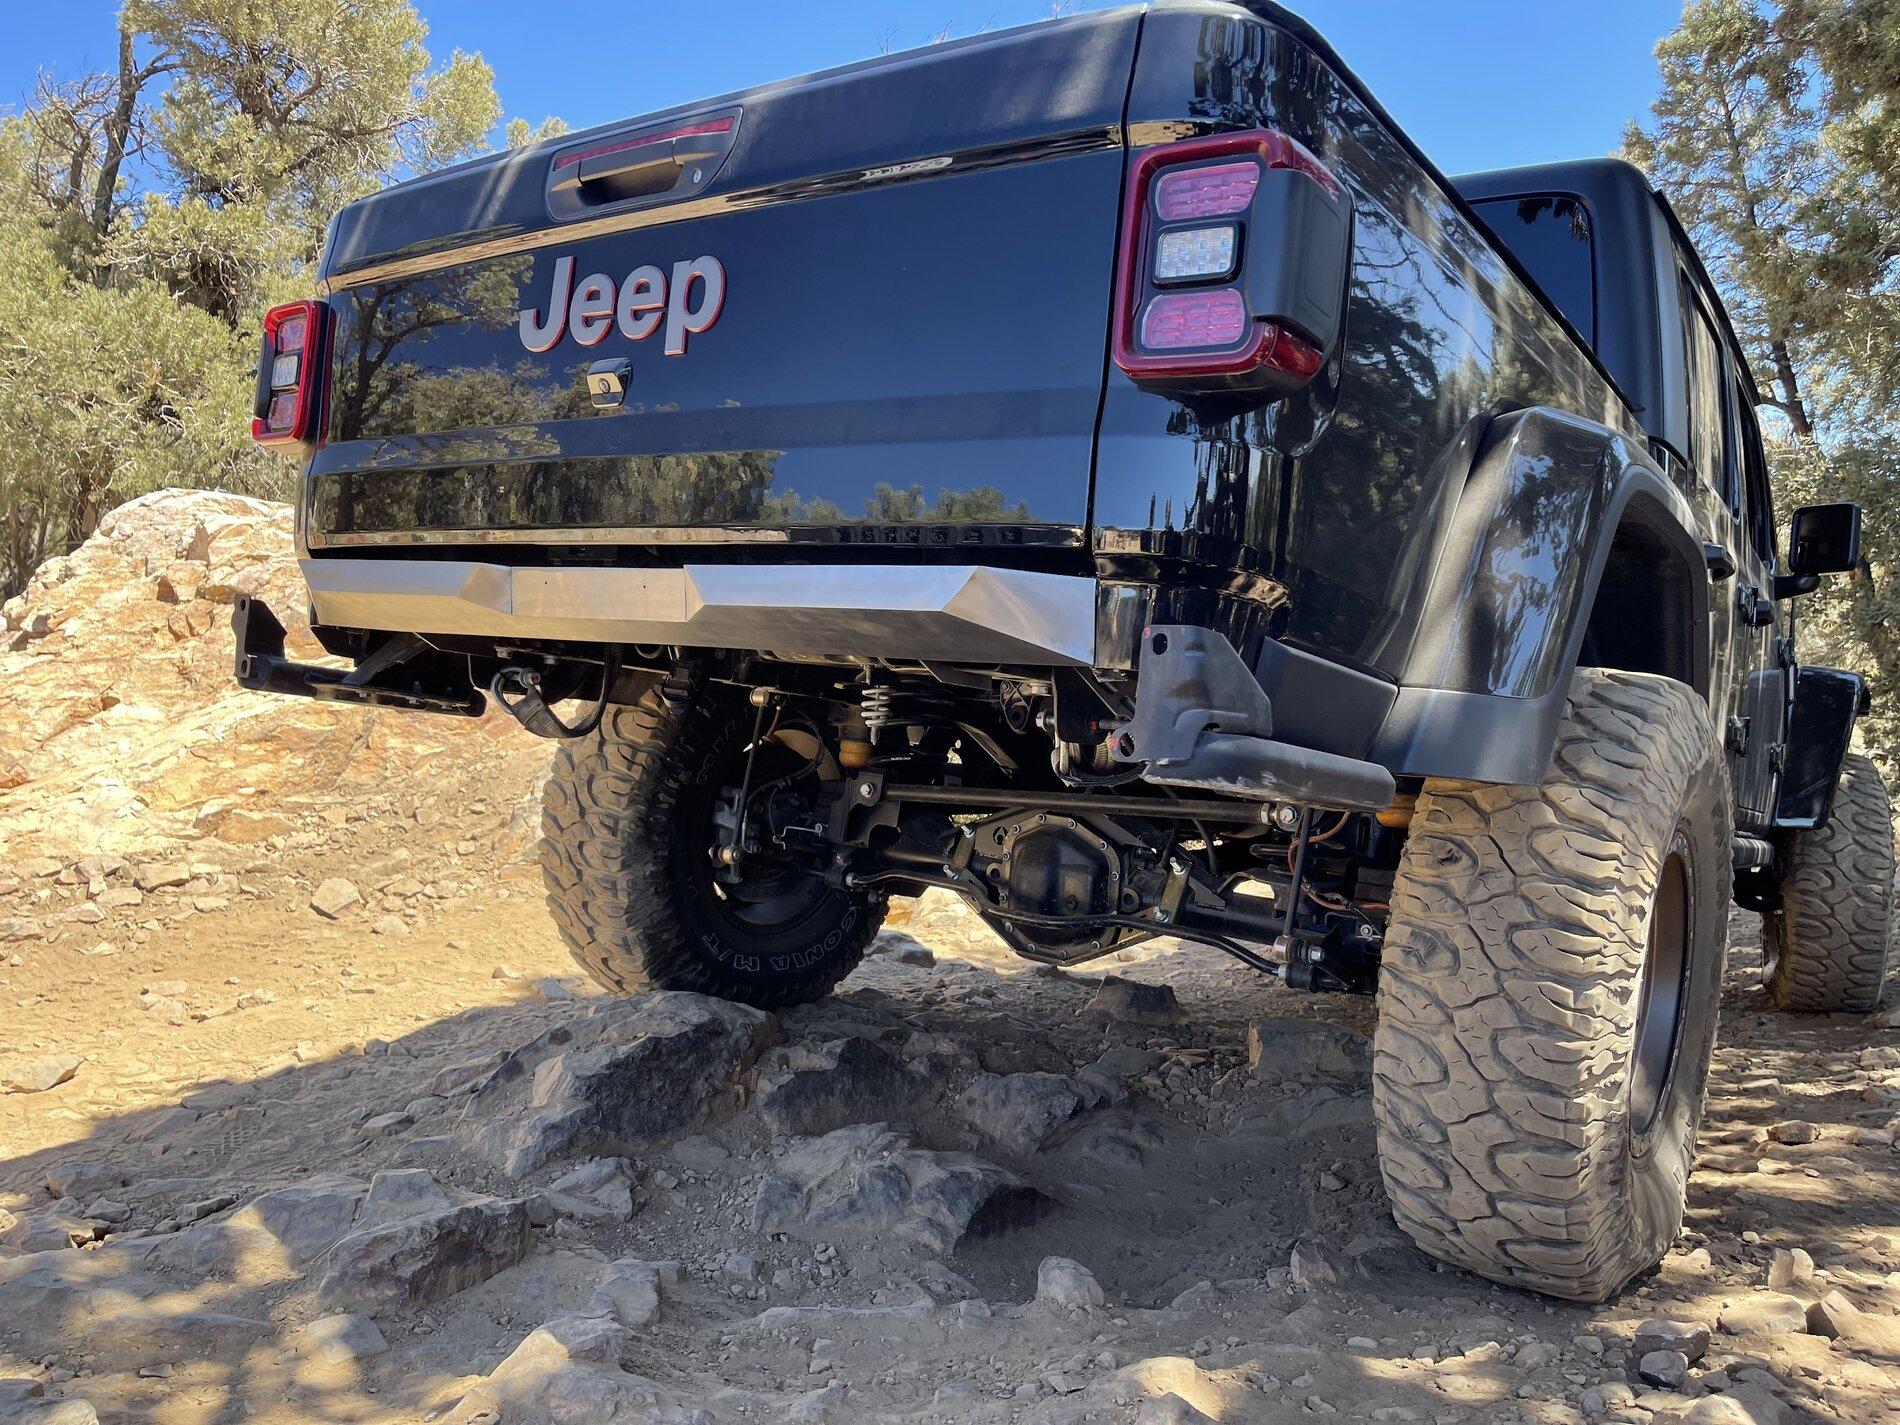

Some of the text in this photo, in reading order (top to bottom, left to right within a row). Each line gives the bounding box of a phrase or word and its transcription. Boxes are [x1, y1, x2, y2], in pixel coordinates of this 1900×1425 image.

[519, 254, 727, 356] Jeep
[702, 908, 857, 972] GONIA M/T
